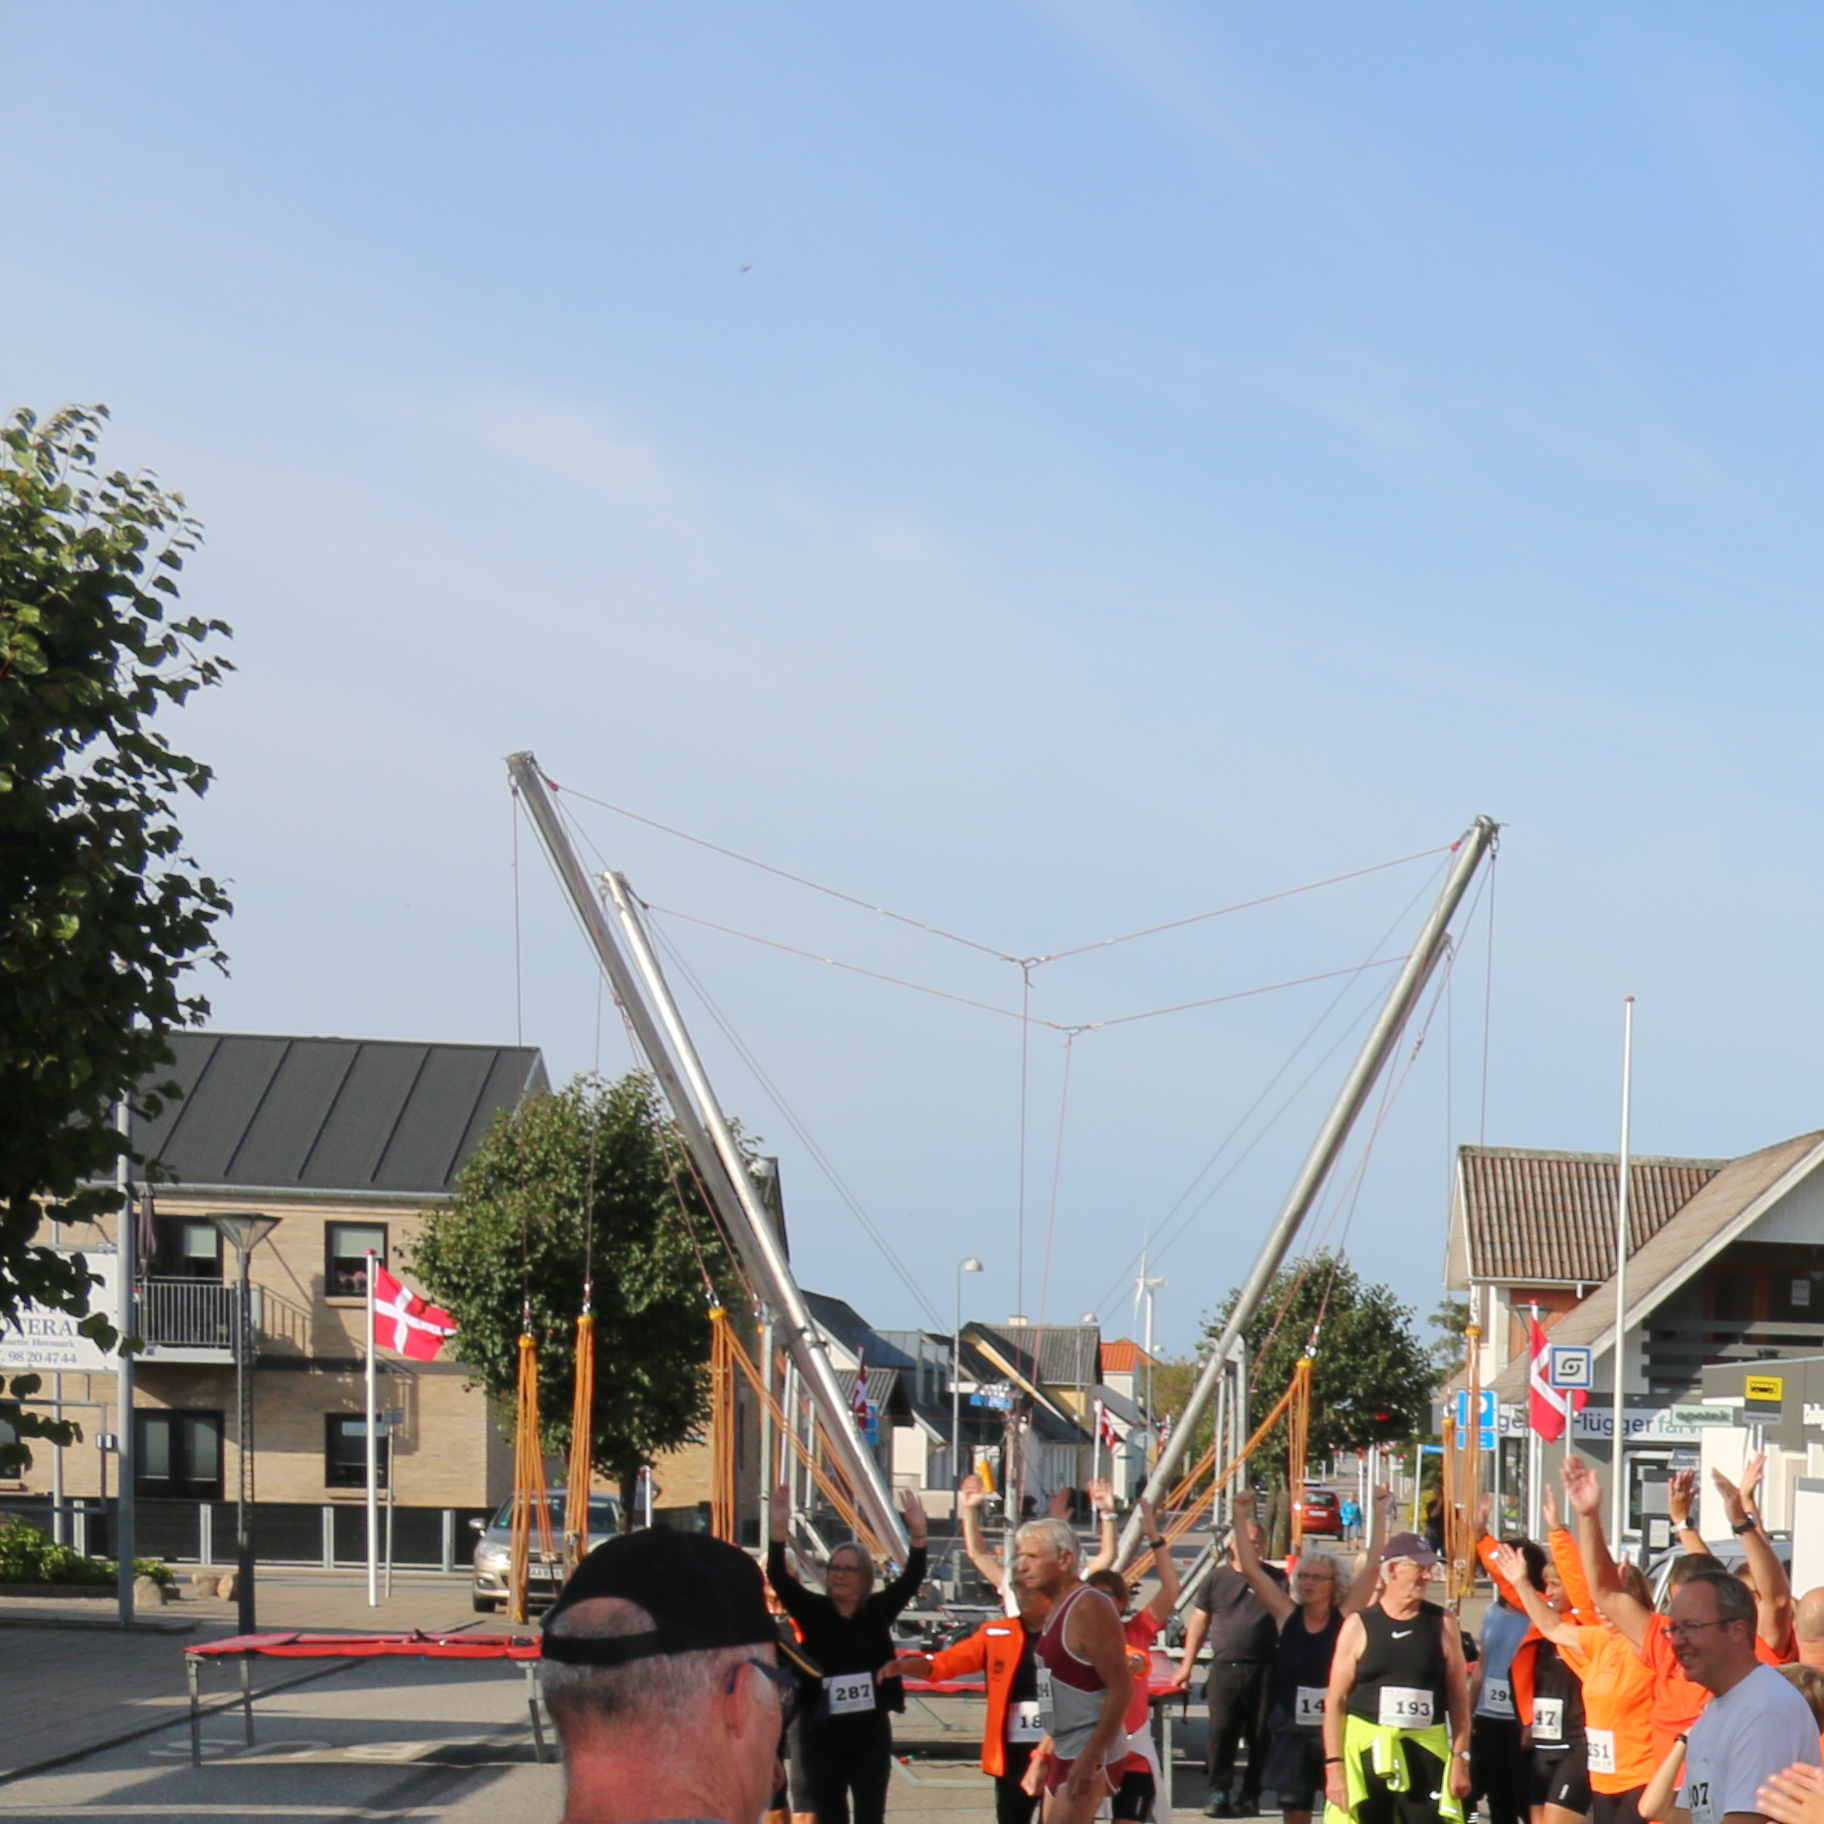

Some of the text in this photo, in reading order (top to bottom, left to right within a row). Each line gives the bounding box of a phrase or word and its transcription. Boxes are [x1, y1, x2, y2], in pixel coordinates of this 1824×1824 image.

[835, 1684, 871, 1702] 287
[1396, 1700, 1430, 1716] 193
[1689, 1782, 1709, 1808] 07
